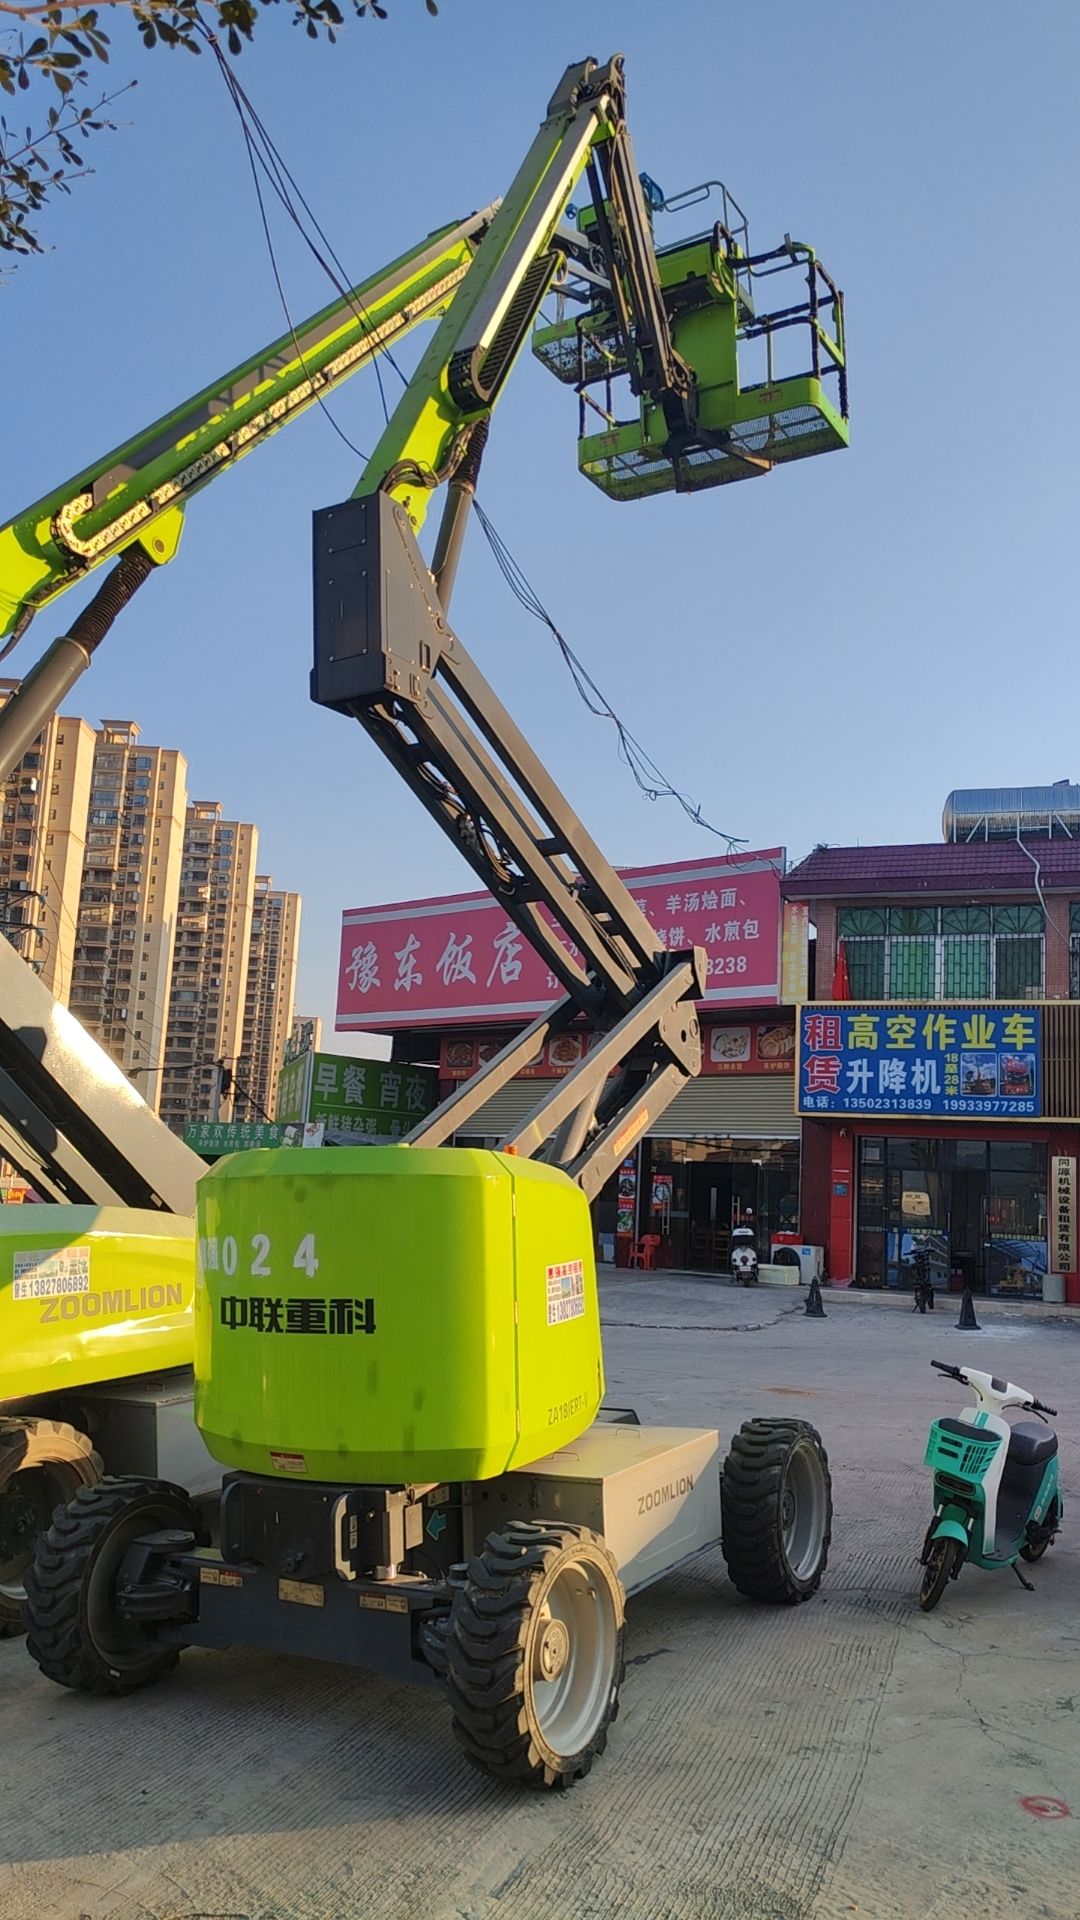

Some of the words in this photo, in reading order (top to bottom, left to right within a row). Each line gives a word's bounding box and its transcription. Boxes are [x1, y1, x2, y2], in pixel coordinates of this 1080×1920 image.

[345, 921, 523, 993] 豫东饭店
[847, 1013, 1036, 1051] 高空作业车
[803, 1013, 844, 1095] 租赁
[313, 1062, 366, 1105] 早餐
[380, 1069, 428, 1111] 宵夜
[845, 1057, 942, 1095] 升降机
[843, 1097, 932, 1110] 13502313839
[942, 1099, 1035, 1113] 19933977285
[187, 1123, 280, 1141] 万家欢传统美食
[1057, 1158, 1071, 1272] 同源机械设备租赁有限公司
[39, 1283, 183, 1324] ZOOMLION
[220, 1295, 377, 1335] 中联重科
[637, 1473, 694, 1516] ZOOMLION
